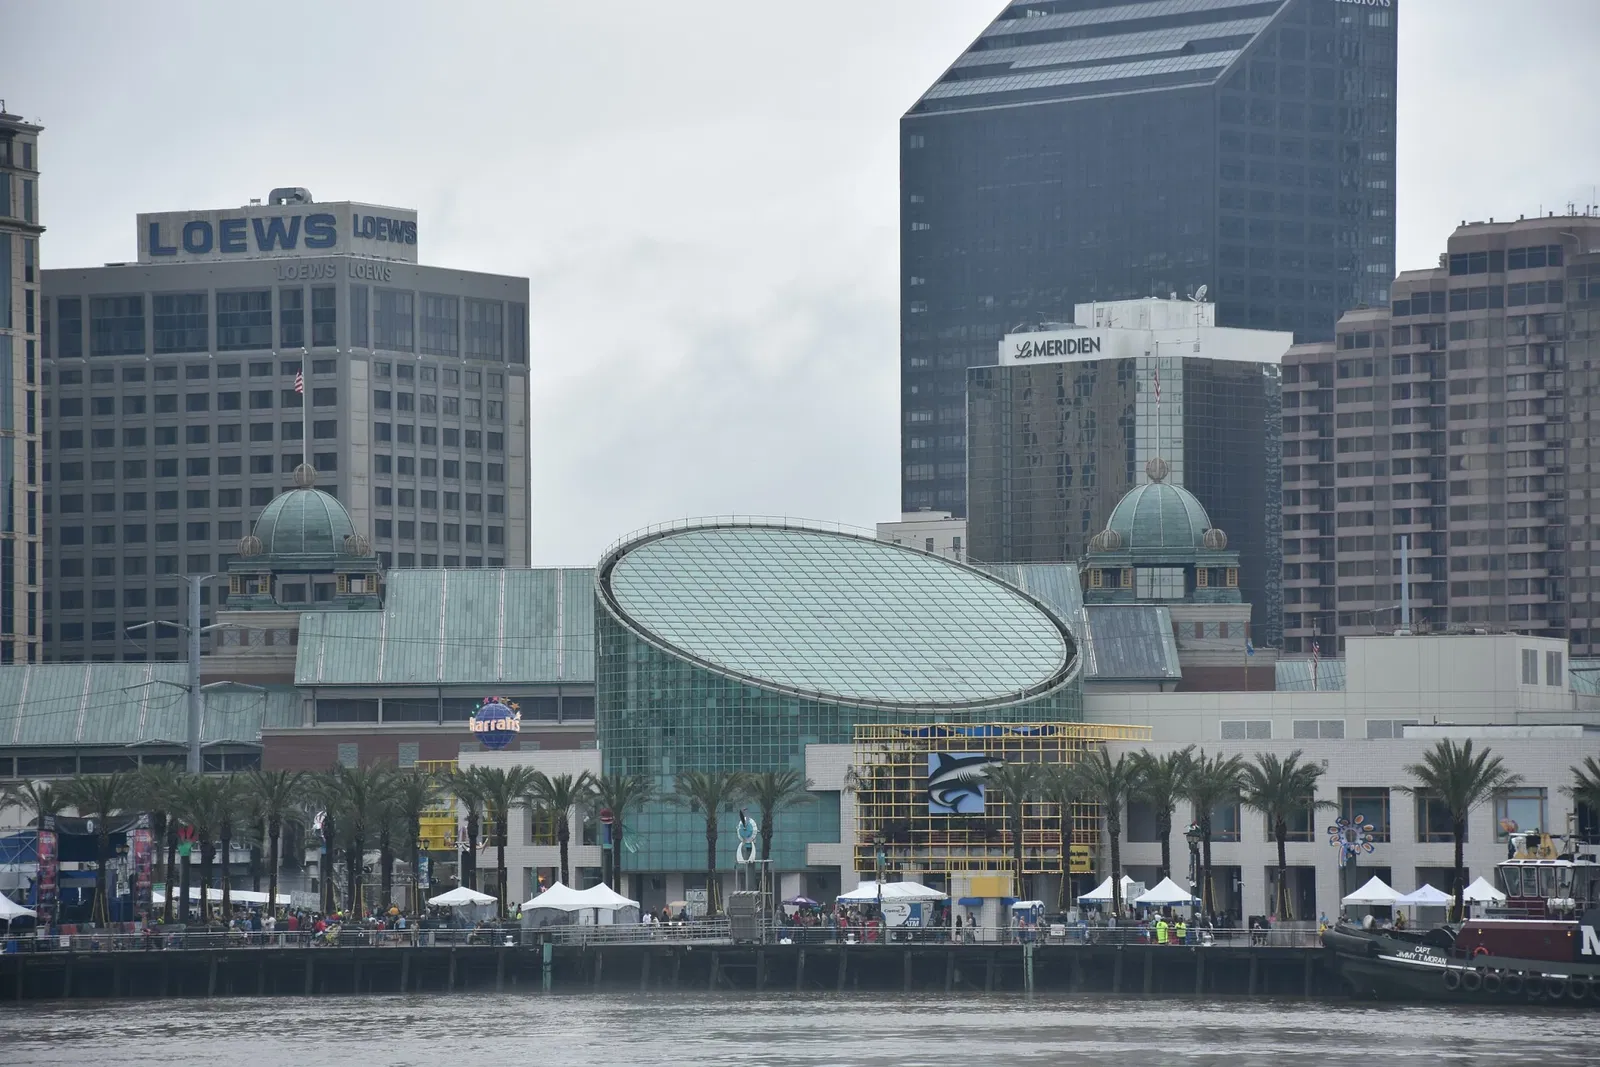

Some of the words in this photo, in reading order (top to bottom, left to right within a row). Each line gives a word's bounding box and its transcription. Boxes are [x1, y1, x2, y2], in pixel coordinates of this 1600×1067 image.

[149, 213, 337, 257] LOEWS
[353, 213, 418, 245] LOEWS
[276, 263, 337, 281] LOEWS
[348, 262, 392, 282] LOEWS
[1014, 340, 1032, 359] Le
[1033, 336, 1101, 357] MERIDIEN
[1423, 954, 1448, 965] MORAN
